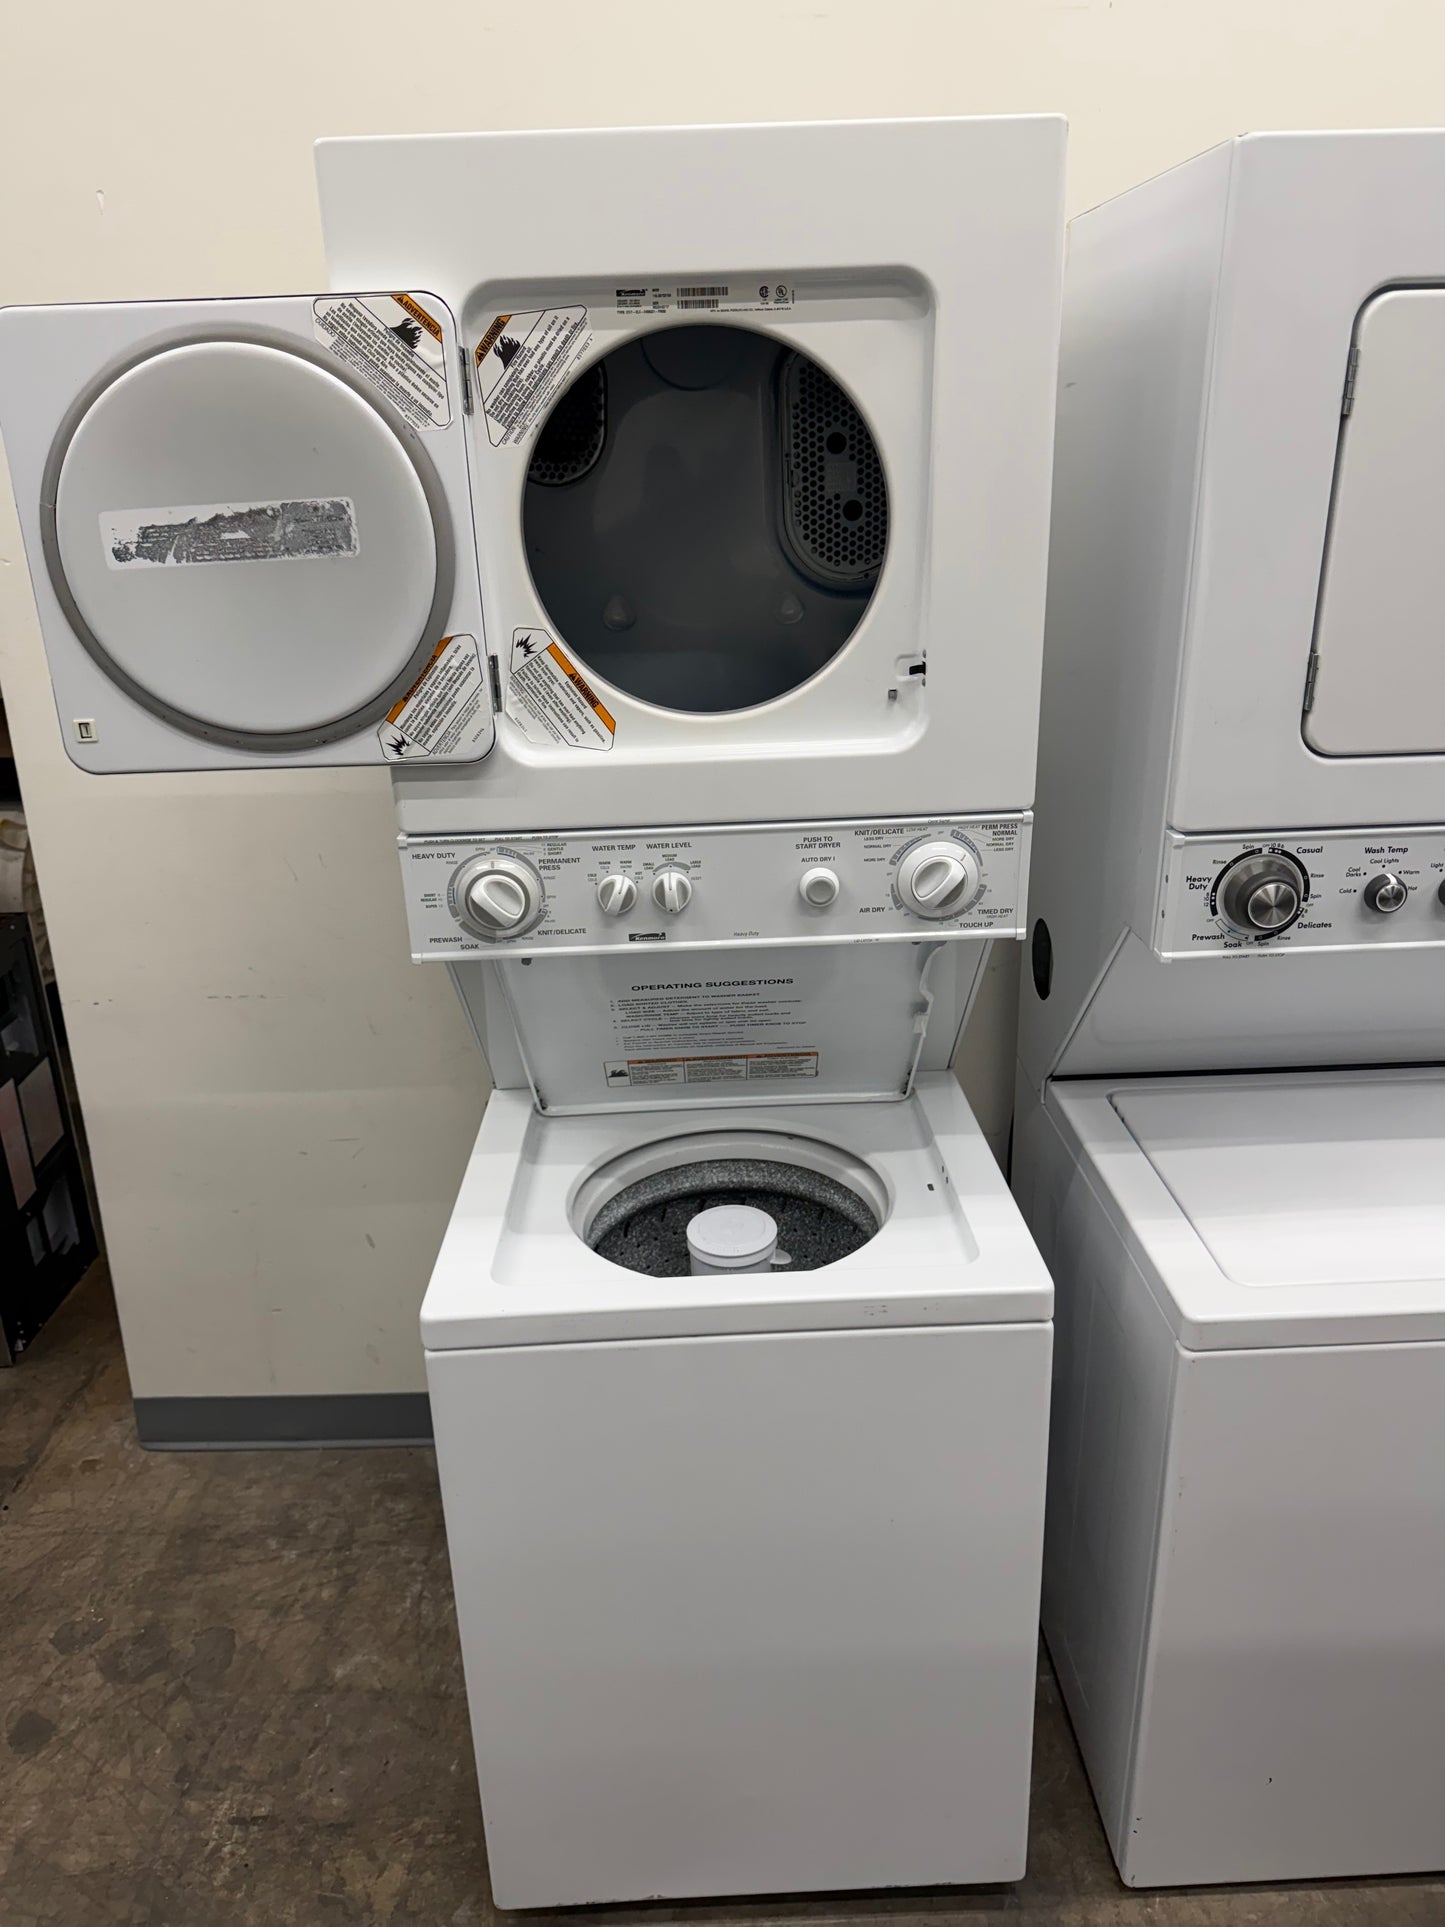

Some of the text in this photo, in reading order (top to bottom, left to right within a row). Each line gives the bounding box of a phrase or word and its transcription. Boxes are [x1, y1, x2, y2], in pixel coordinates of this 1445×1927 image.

[403, 300, 440, 337] ADVERTENCIA
[481, 318, 505, 353] WARNING
[573, 678, 600, 708] WARNING
[854, 828, 905, 836] KNIT/DELICATE
[1296, 846, 1323, 854] Casual
[1388, 846, 1409, 854] Temp
[537, 928, 587, 936] KNIT/DELICATE
[634, 933, 666, 942] Kenmore
[1191, 933, 1225, 941] Prewash
[631, 978, 794, 991] OPERATING SUGGESTIONS
